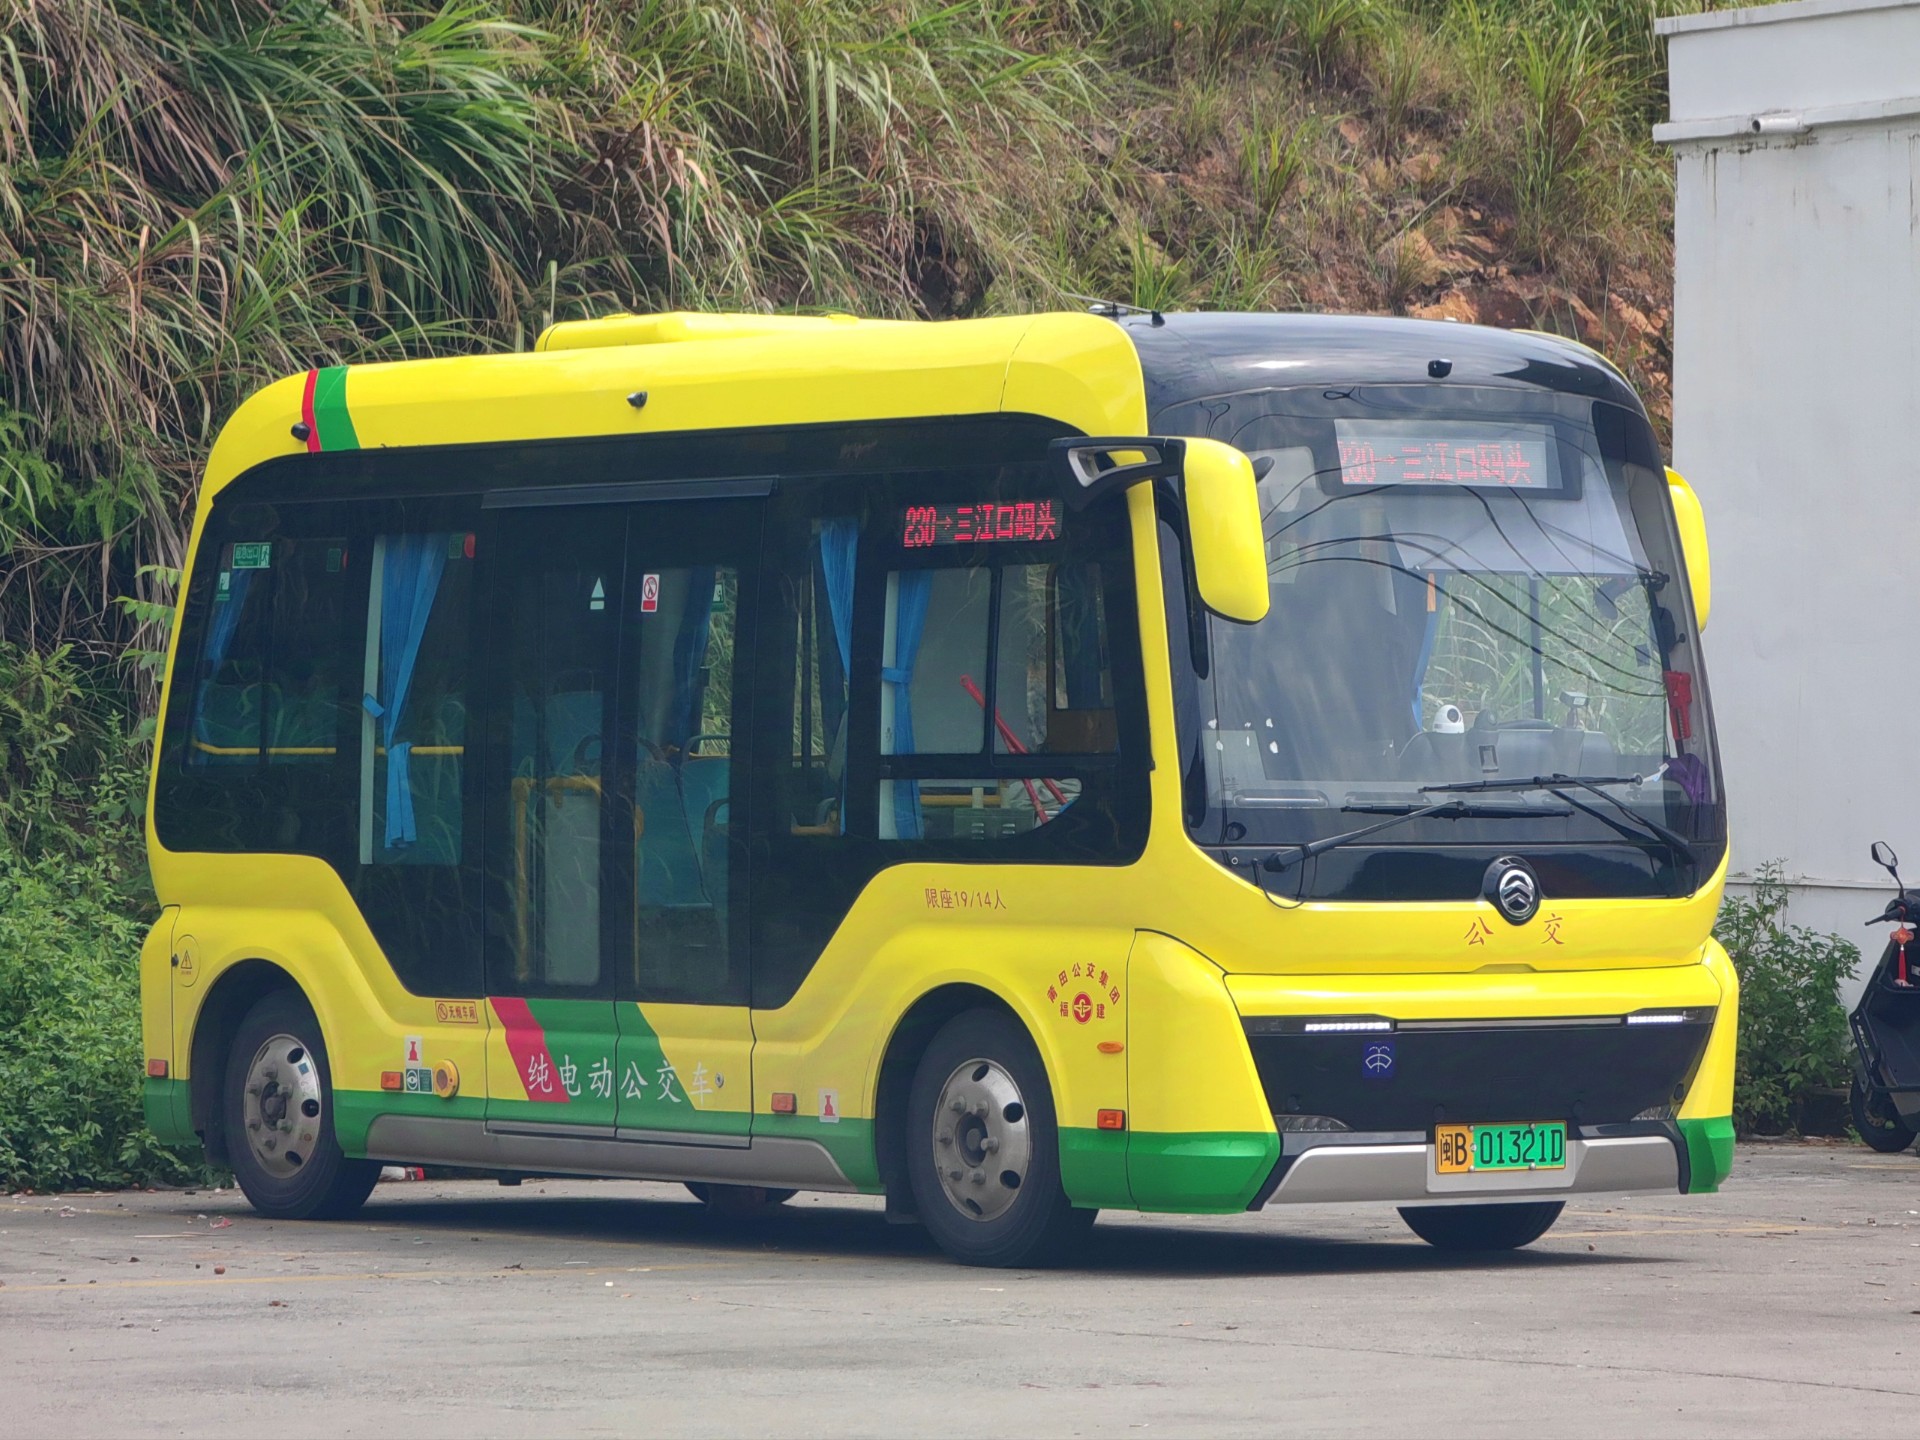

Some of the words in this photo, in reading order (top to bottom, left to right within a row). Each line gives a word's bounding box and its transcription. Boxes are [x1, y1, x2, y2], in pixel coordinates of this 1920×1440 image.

[1402, 442, 1532, 484] 三江口码头
[904, 506, 937, 547] 230
[954, 499, 1056, 541] 三江口码头
[925, 888, 1006, 910] 限座19/14人
[1047, 962, 1120, 1005] 莆田公交集团
[527, 1052, 713, 1105] 纯电动公交车
